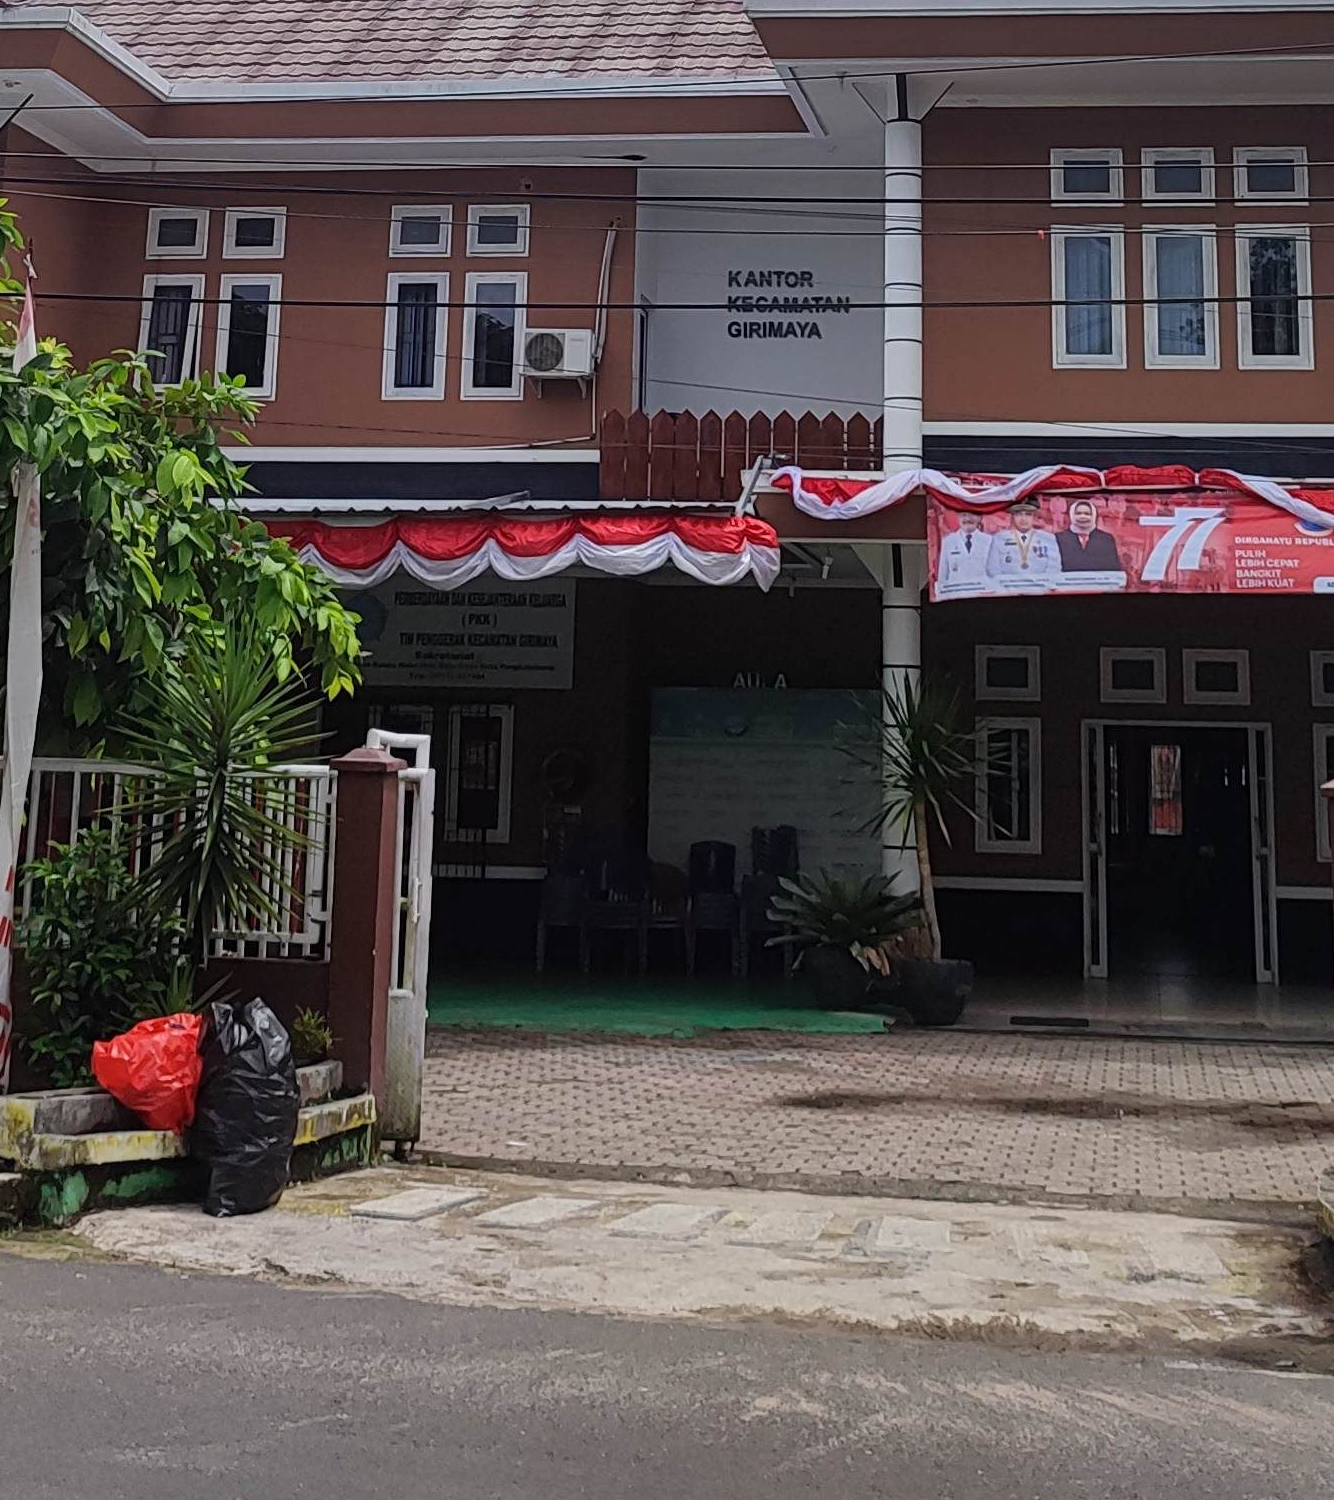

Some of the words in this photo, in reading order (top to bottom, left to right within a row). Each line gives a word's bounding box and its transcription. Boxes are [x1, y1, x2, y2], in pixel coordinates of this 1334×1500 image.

[728, 270, 814, 288] KANTOR
[727, 295, 850, 313] KECAMATAN
[727, 320, 822, 339] GIRIMAYA
[1139, 508, 1227, 581] 77
[1234, 536, 1293, 546] DIRGAHAYU
[1235, 550, 1267, 559] PULIH
[1235, 559, 1265, 569] LEBIH
[1266, 560, 1300, 569] CEPAT
[1236, 570, 1282, 580] BANGKIT
[1236, 579, 1266, 589] LEBIH
[1267, 580, 1296, 589] KUAT
[733, 672, 787, 689] AUA
